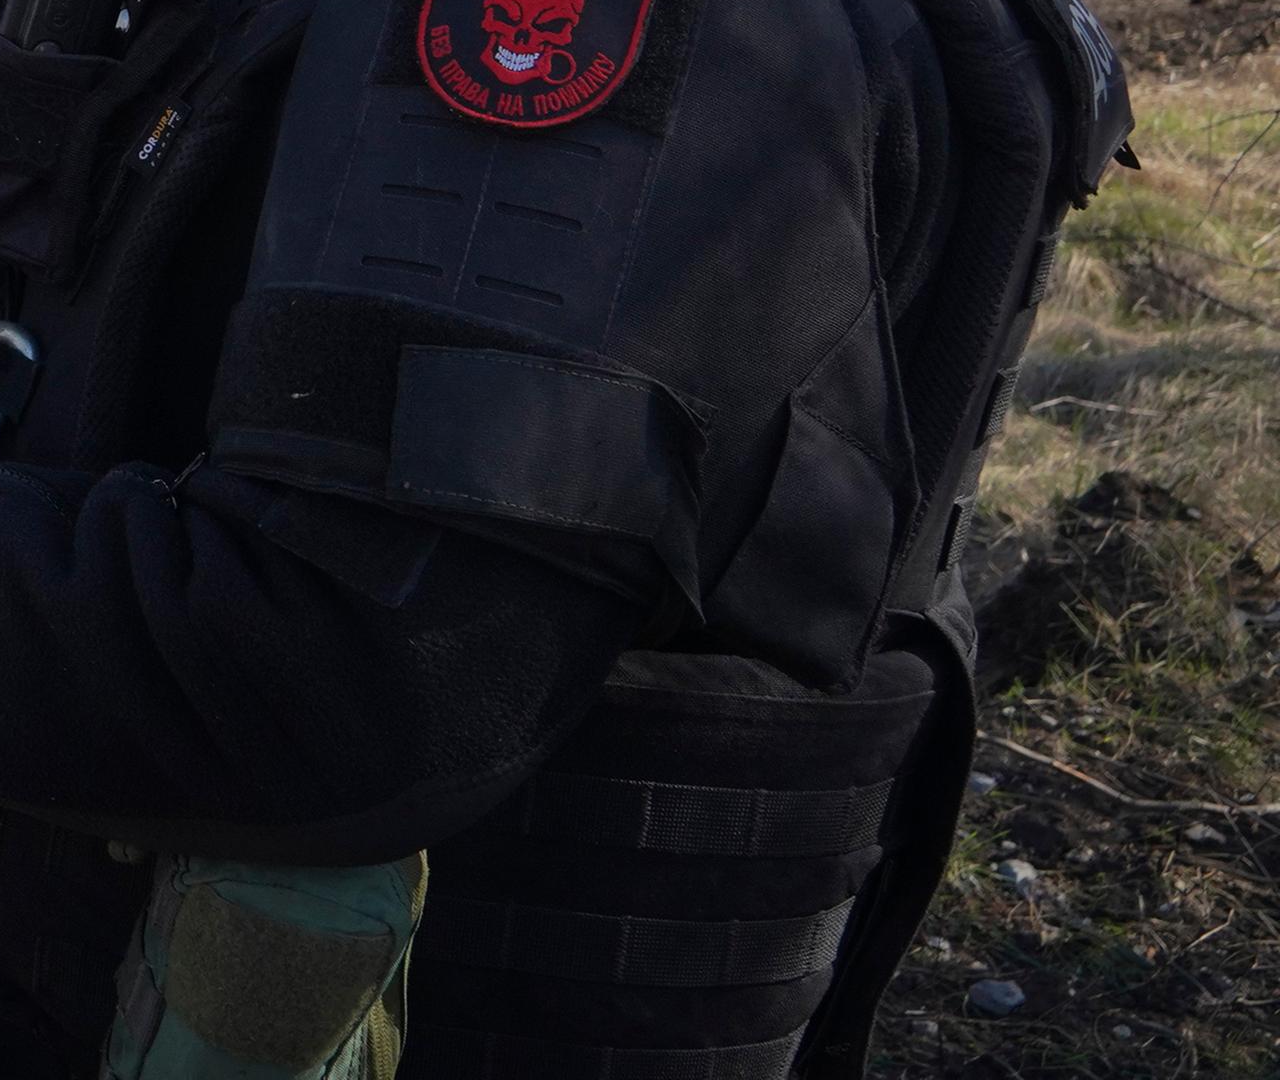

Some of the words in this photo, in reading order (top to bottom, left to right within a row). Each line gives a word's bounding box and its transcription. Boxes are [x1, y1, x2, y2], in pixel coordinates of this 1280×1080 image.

[430, 24, 453, 59] БЕЗ
[440, 58, 491, 110] ПРАВА
[497, 92, 525, 117] НА
[533, 51, 616, 117] ПОМИЛКУ
[138, 108, 174, 160] CORDURA
